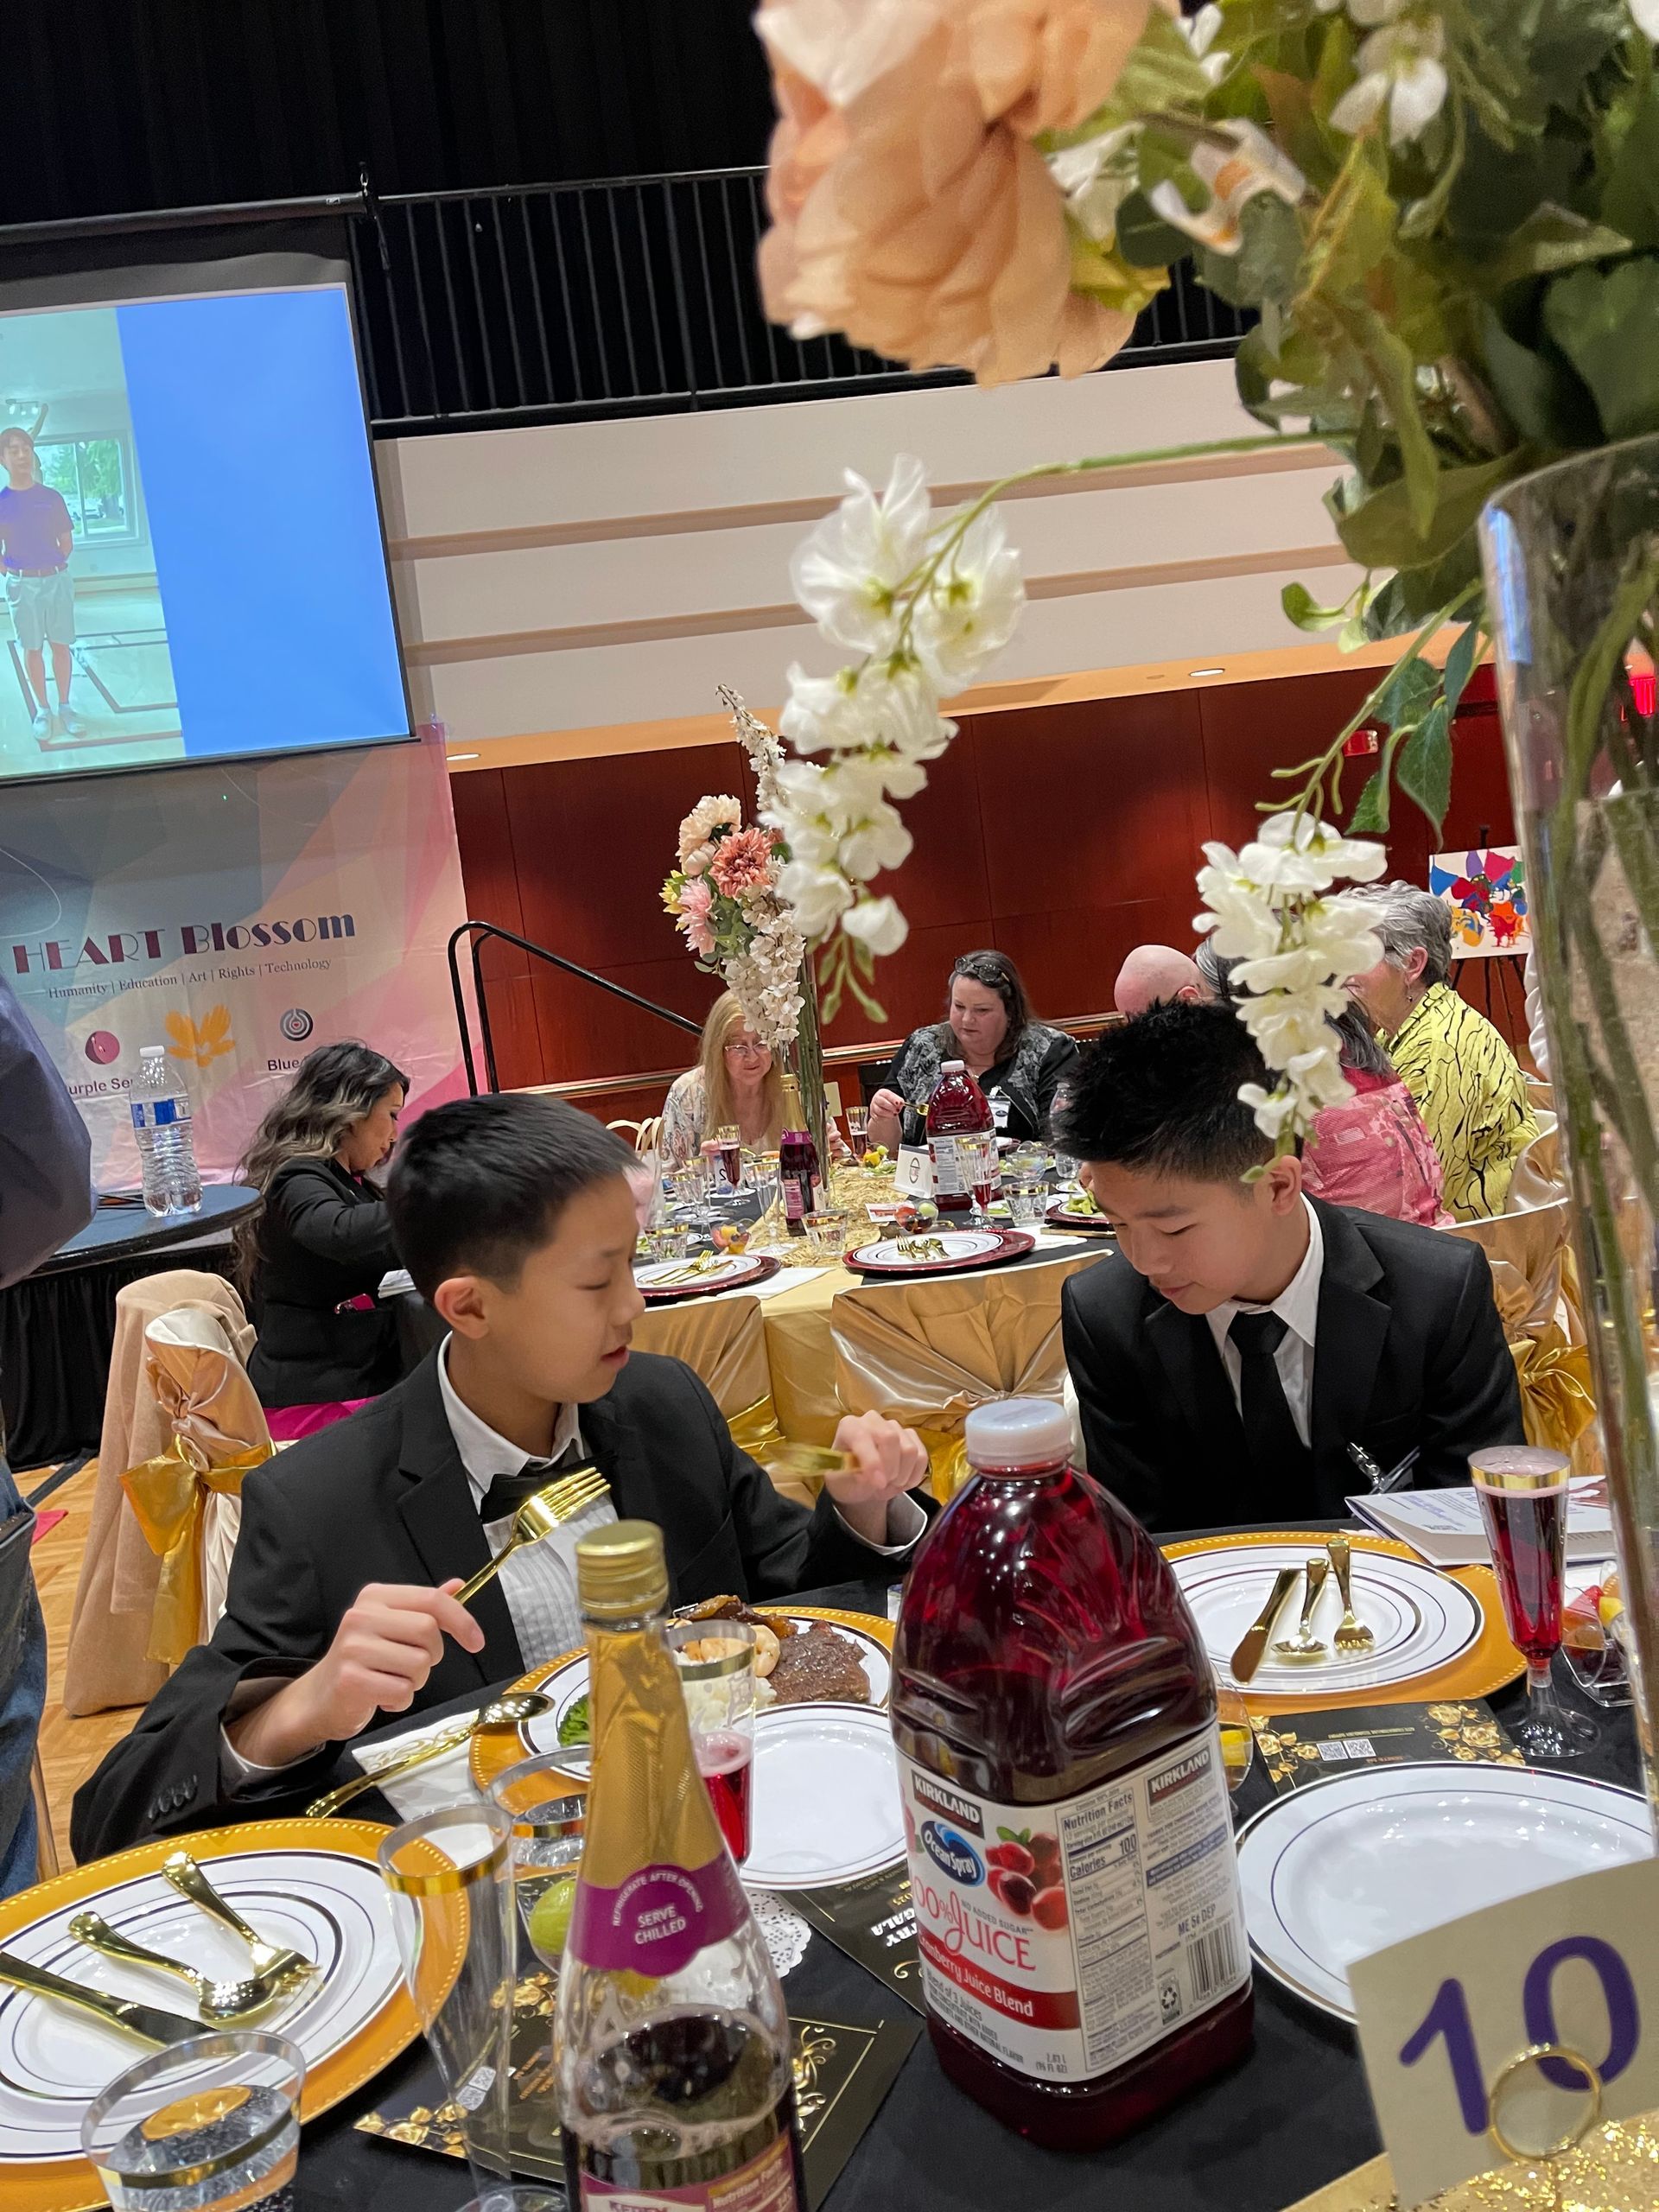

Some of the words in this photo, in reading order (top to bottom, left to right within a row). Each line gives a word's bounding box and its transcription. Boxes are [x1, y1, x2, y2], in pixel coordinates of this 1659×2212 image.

[12, 928, 166, 975] HEART
[48, 982, 108, 1000] Humanity
[119, 975, 178, 992] Education
[188, 971, 207, 984] Art
[218, 966, 256, 981] Rights
[264, 957, 333, 975] Technology
[267, 1058, 301, 1071] Blue
[68, 1079, 107, 1096] urple
[1150, 1749, 1211, 1795] KIRKLAND
[913, 1774, 982, 1825] KIRKLAND
[1064, 1807, 1106, 1831] Nutrition
[1108, 1793, 1133, 1814] Facts
[923, 1830, 952, 1869] Ocean
[1120, 1833, 1137, 1855] 100
[650, 1872, 678, 1883] AFTER
[1070, 1855, 1106, 1878] Calories
[634, 1916, 687, 1945] CHILLED
[638, 1904, 677, 1929] SERVE
[871, 1907, 917, 1936] GALA
[1178, 1918, 1190, 1936] ME
[1200, 1904, 1217, 1923] DEP
[963, 1967, 993, 1999] Juice
[993, 1985, 1034, 2018] Blend
[1397, 1934, 1640, 2137] 10
